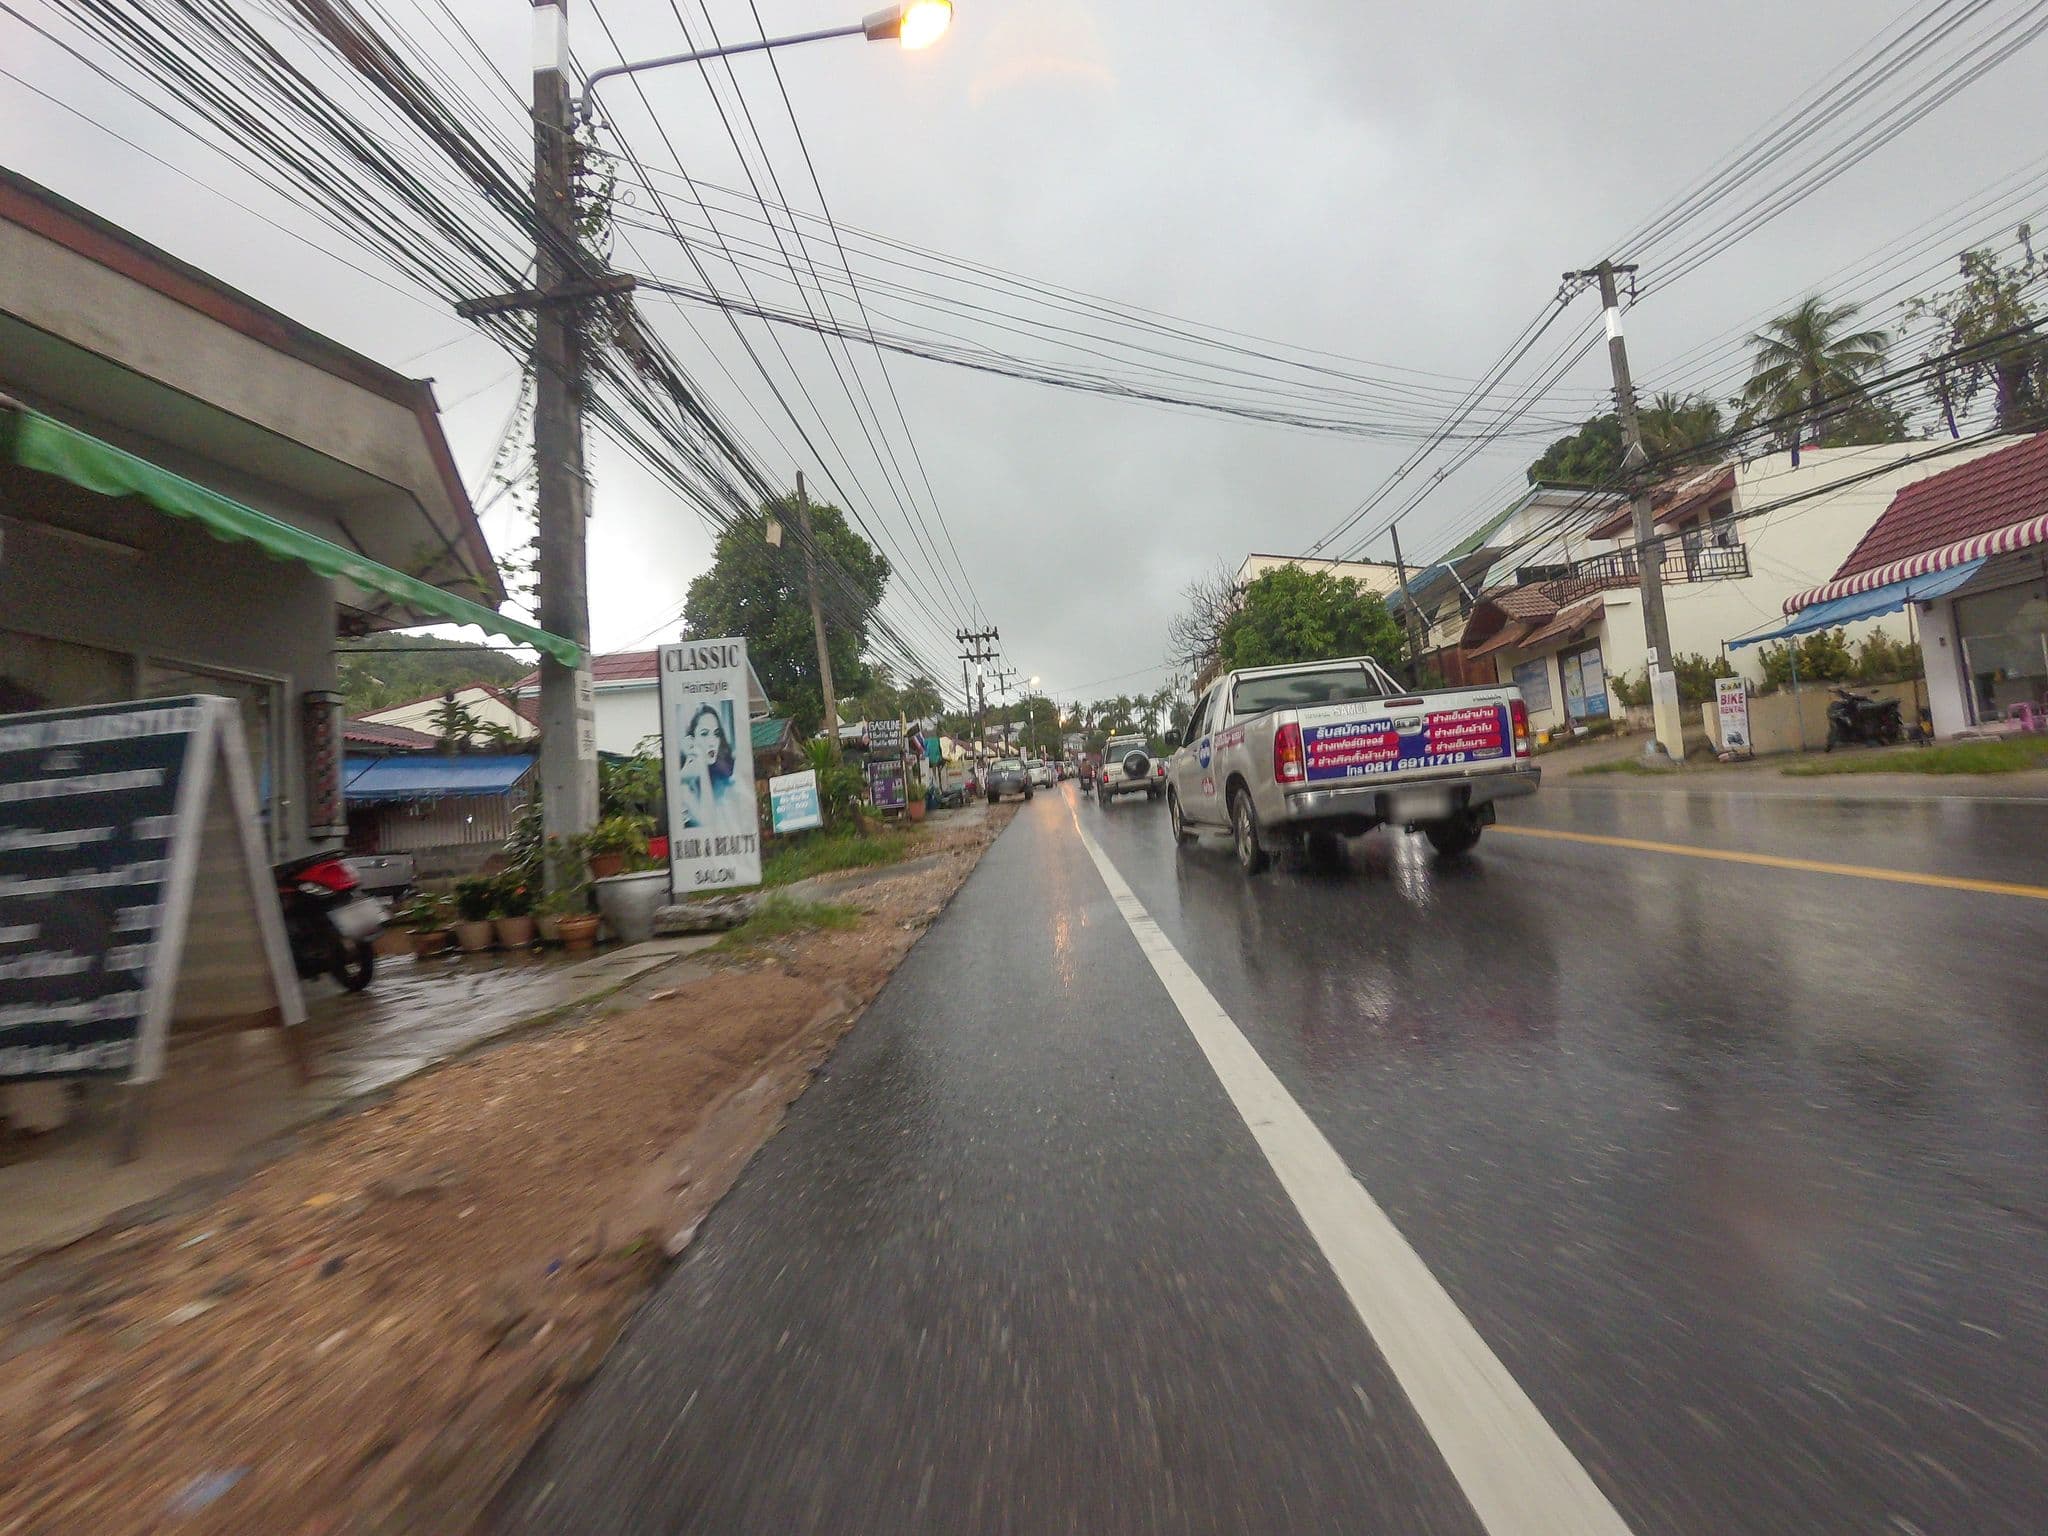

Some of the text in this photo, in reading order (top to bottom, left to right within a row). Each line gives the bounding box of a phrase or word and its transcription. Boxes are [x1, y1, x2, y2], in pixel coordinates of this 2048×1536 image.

[665, 645, 738, 673] CLASSIC
[682, 679, 728, 696] Hairstyle
[1721, 693, 1744, 705] BIKE
[1720, 705, 1745, 715] RENTAL
[1317, 721, 1391, 740] รับสมัครงาน
[1364, 760, 1393, 775] 081
[715, 833, 758, 857] BEAUTY
[695, 866, 738, 886] SALON
